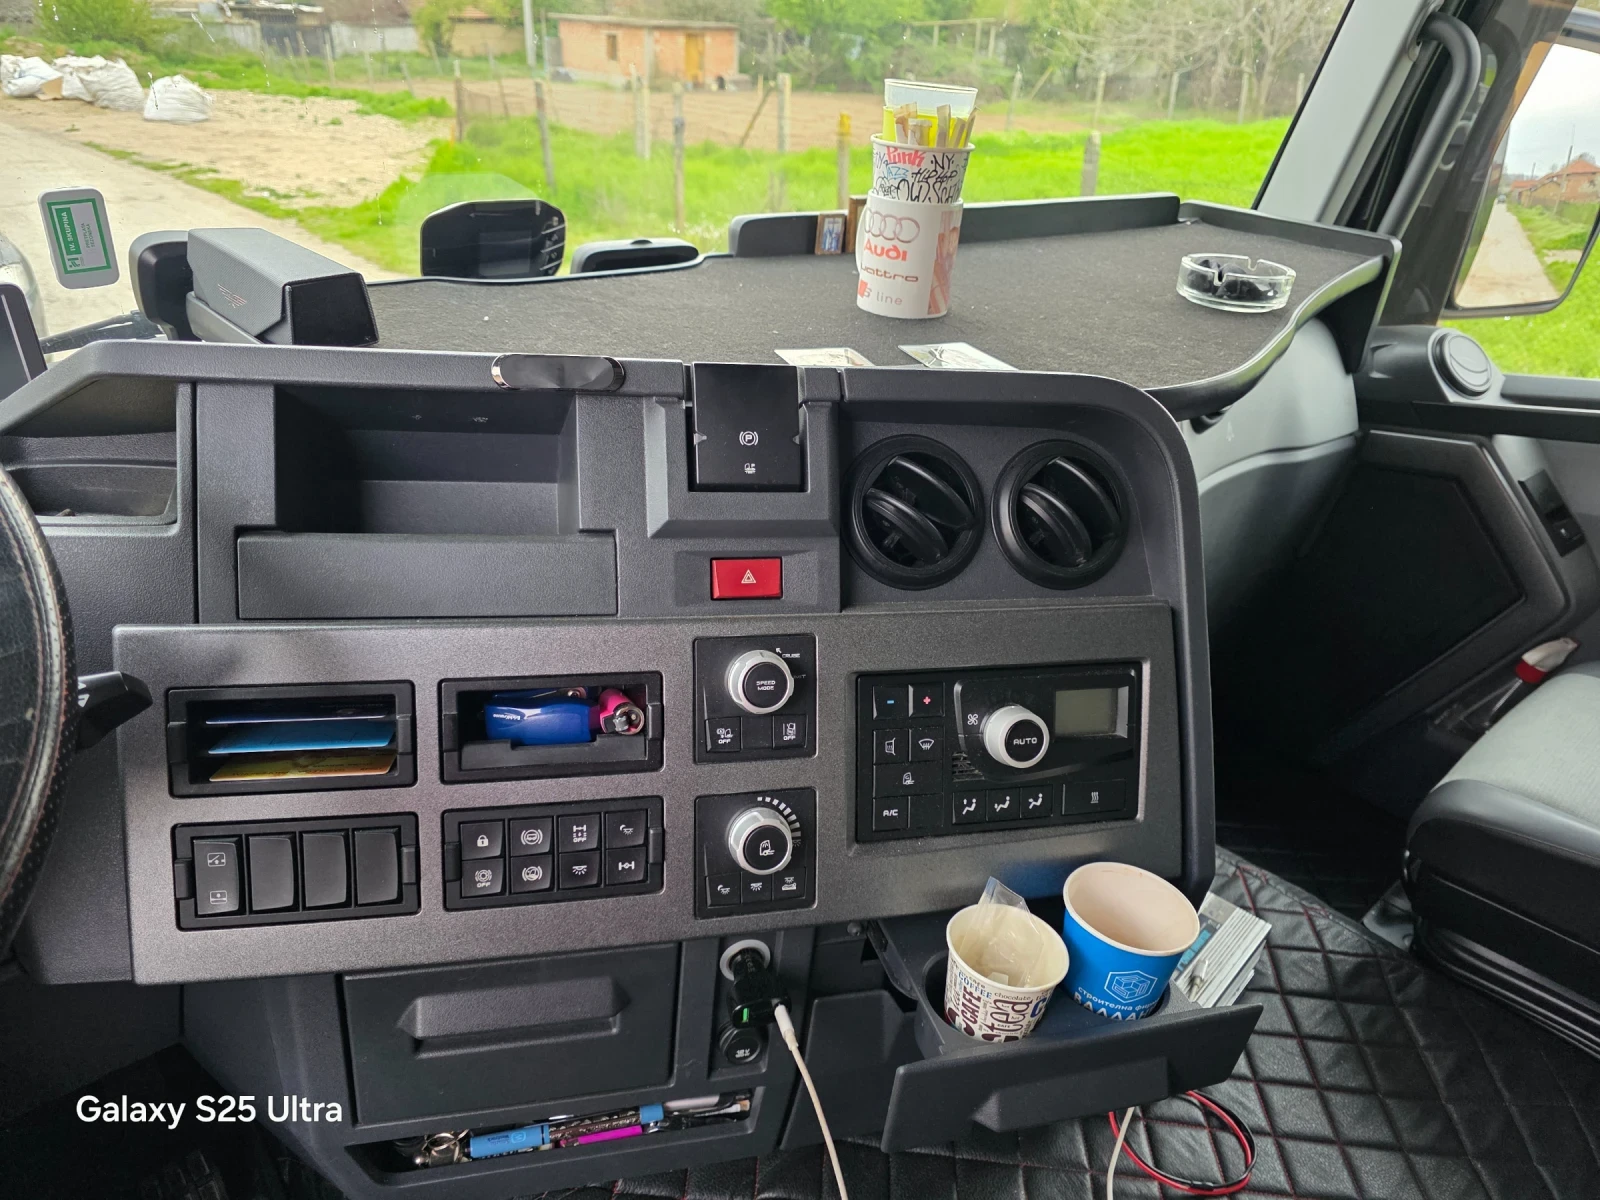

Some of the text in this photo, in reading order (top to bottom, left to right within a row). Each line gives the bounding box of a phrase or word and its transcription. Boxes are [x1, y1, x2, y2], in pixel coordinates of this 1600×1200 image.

[886, 145, 926, 167] Punk
[61, 211, 74, 242] SKUPINA
[864, 238, 908, 261] Audi
[860, 262, 919, 282] uattro
[876, 290, 903, 306] line
[1013, 736, 1038, 745] AUTO
[883, 809, 898, 817] A/C
[960, 986, 982, 1025] CAFE
[994, 992, 1031, 1001] chocolate
[1078, 986, 1133, 1011] строителна
